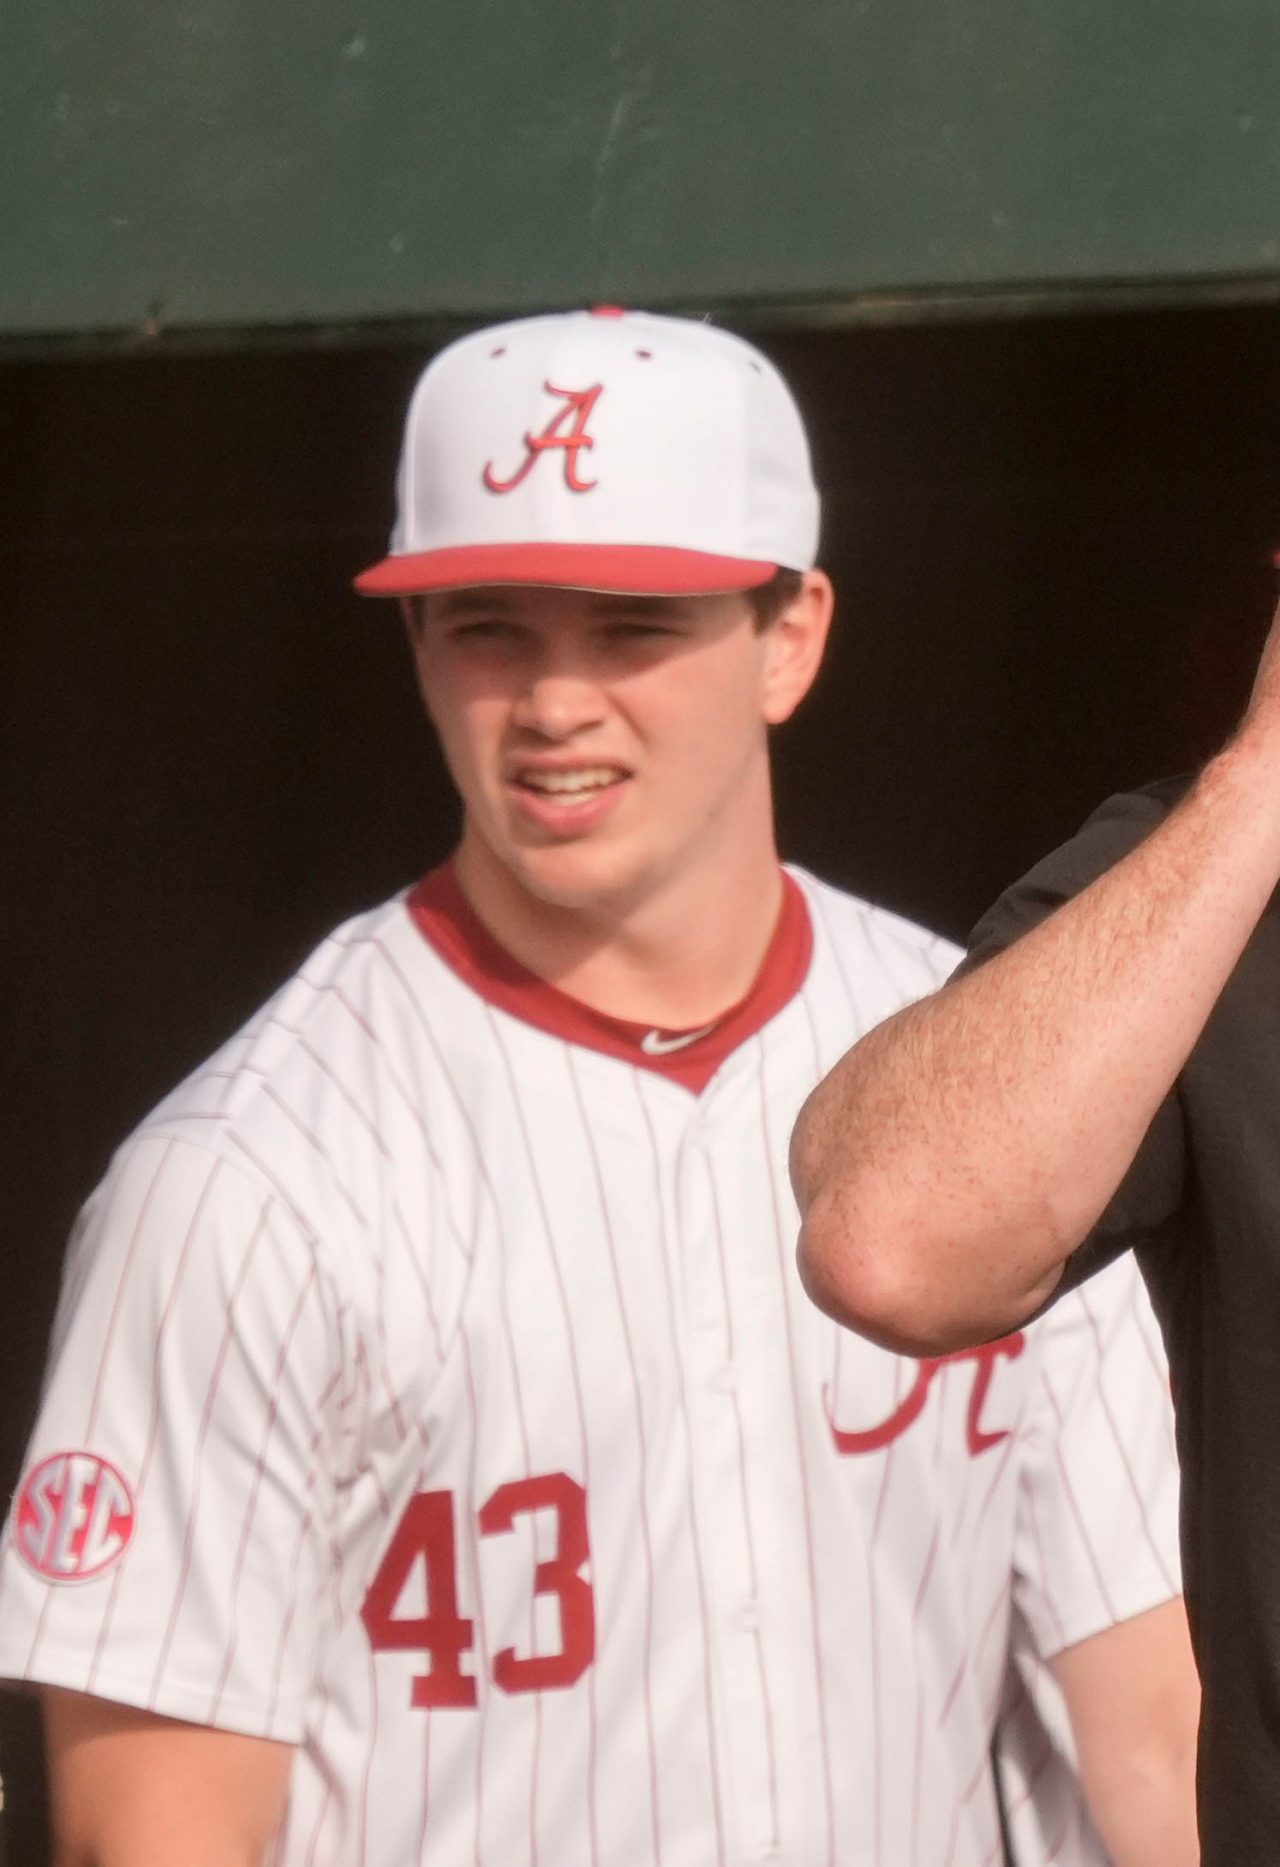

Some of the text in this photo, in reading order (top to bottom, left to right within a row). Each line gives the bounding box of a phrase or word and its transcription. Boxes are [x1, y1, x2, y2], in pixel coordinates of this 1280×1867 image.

[482, 381, 603, 495] A
[24, 1455, 132, 1572] SEC
[361, 1472, 596, 1708] 43
